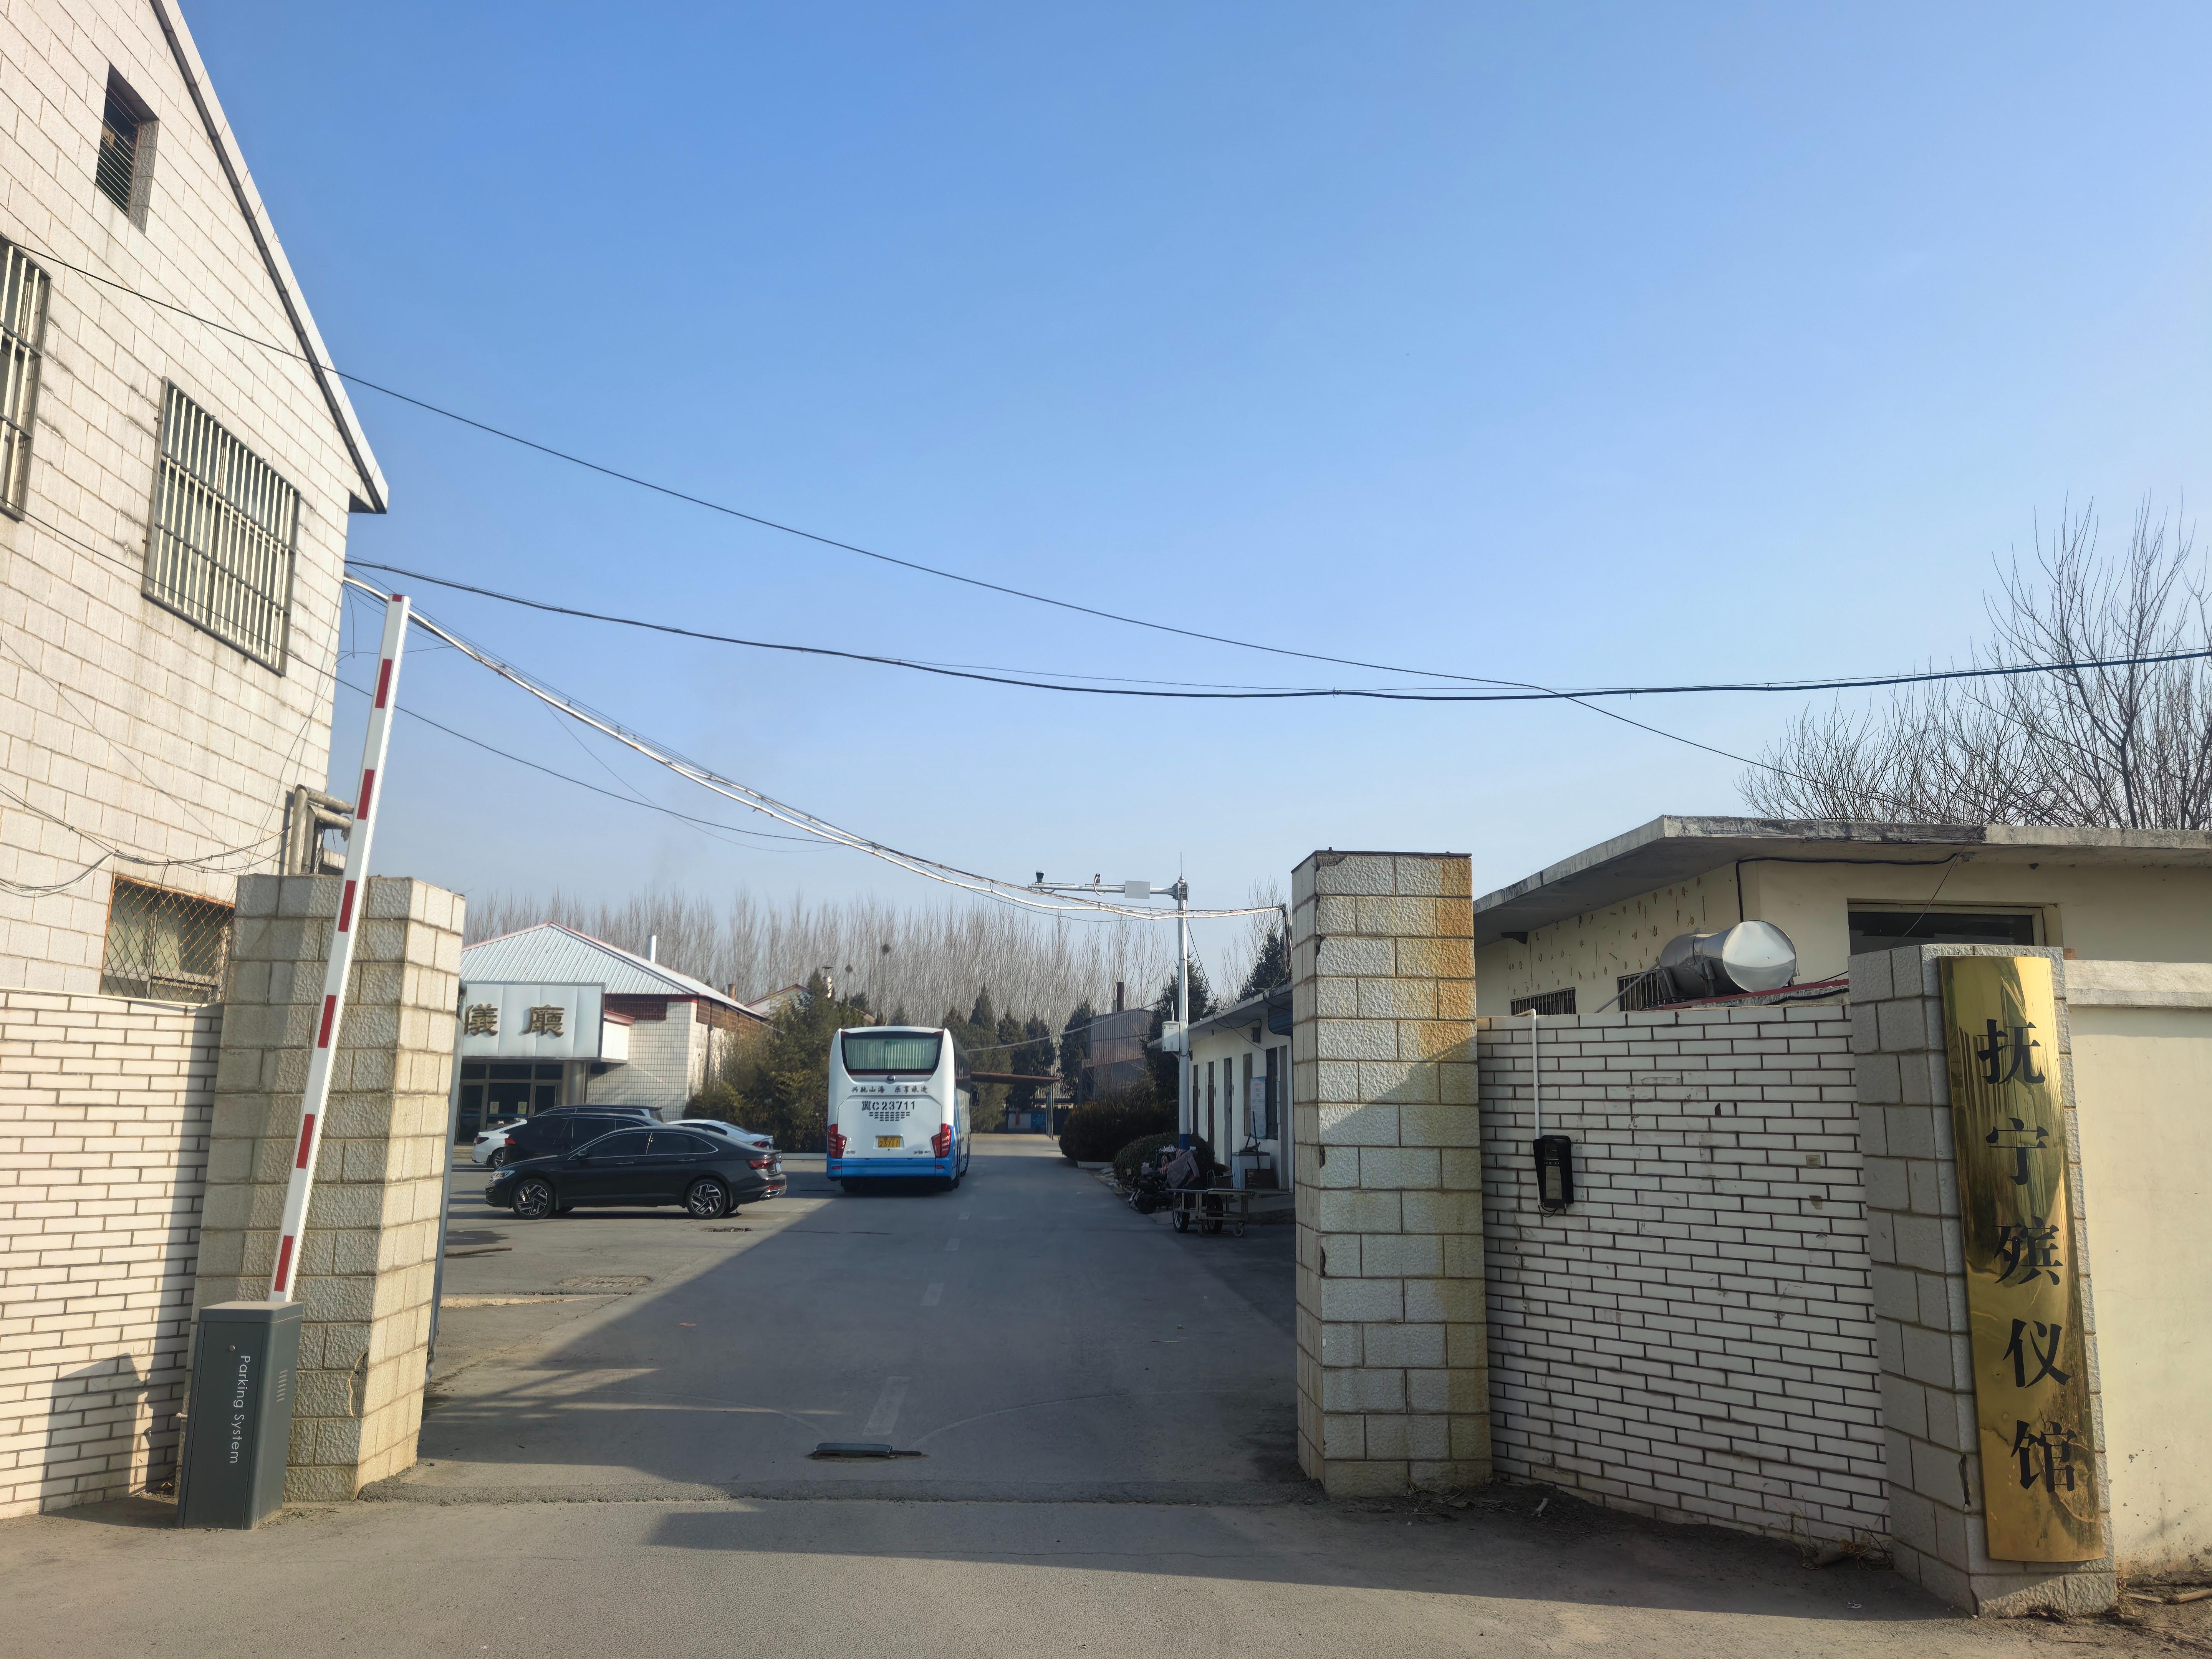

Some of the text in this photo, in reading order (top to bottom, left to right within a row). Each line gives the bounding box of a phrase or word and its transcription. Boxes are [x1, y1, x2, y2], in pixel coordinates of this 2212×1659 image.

[1977, 1018, 2077, 1493] 抚宁殡仪馆
[230, 1355, 251, 1463] Parking System
